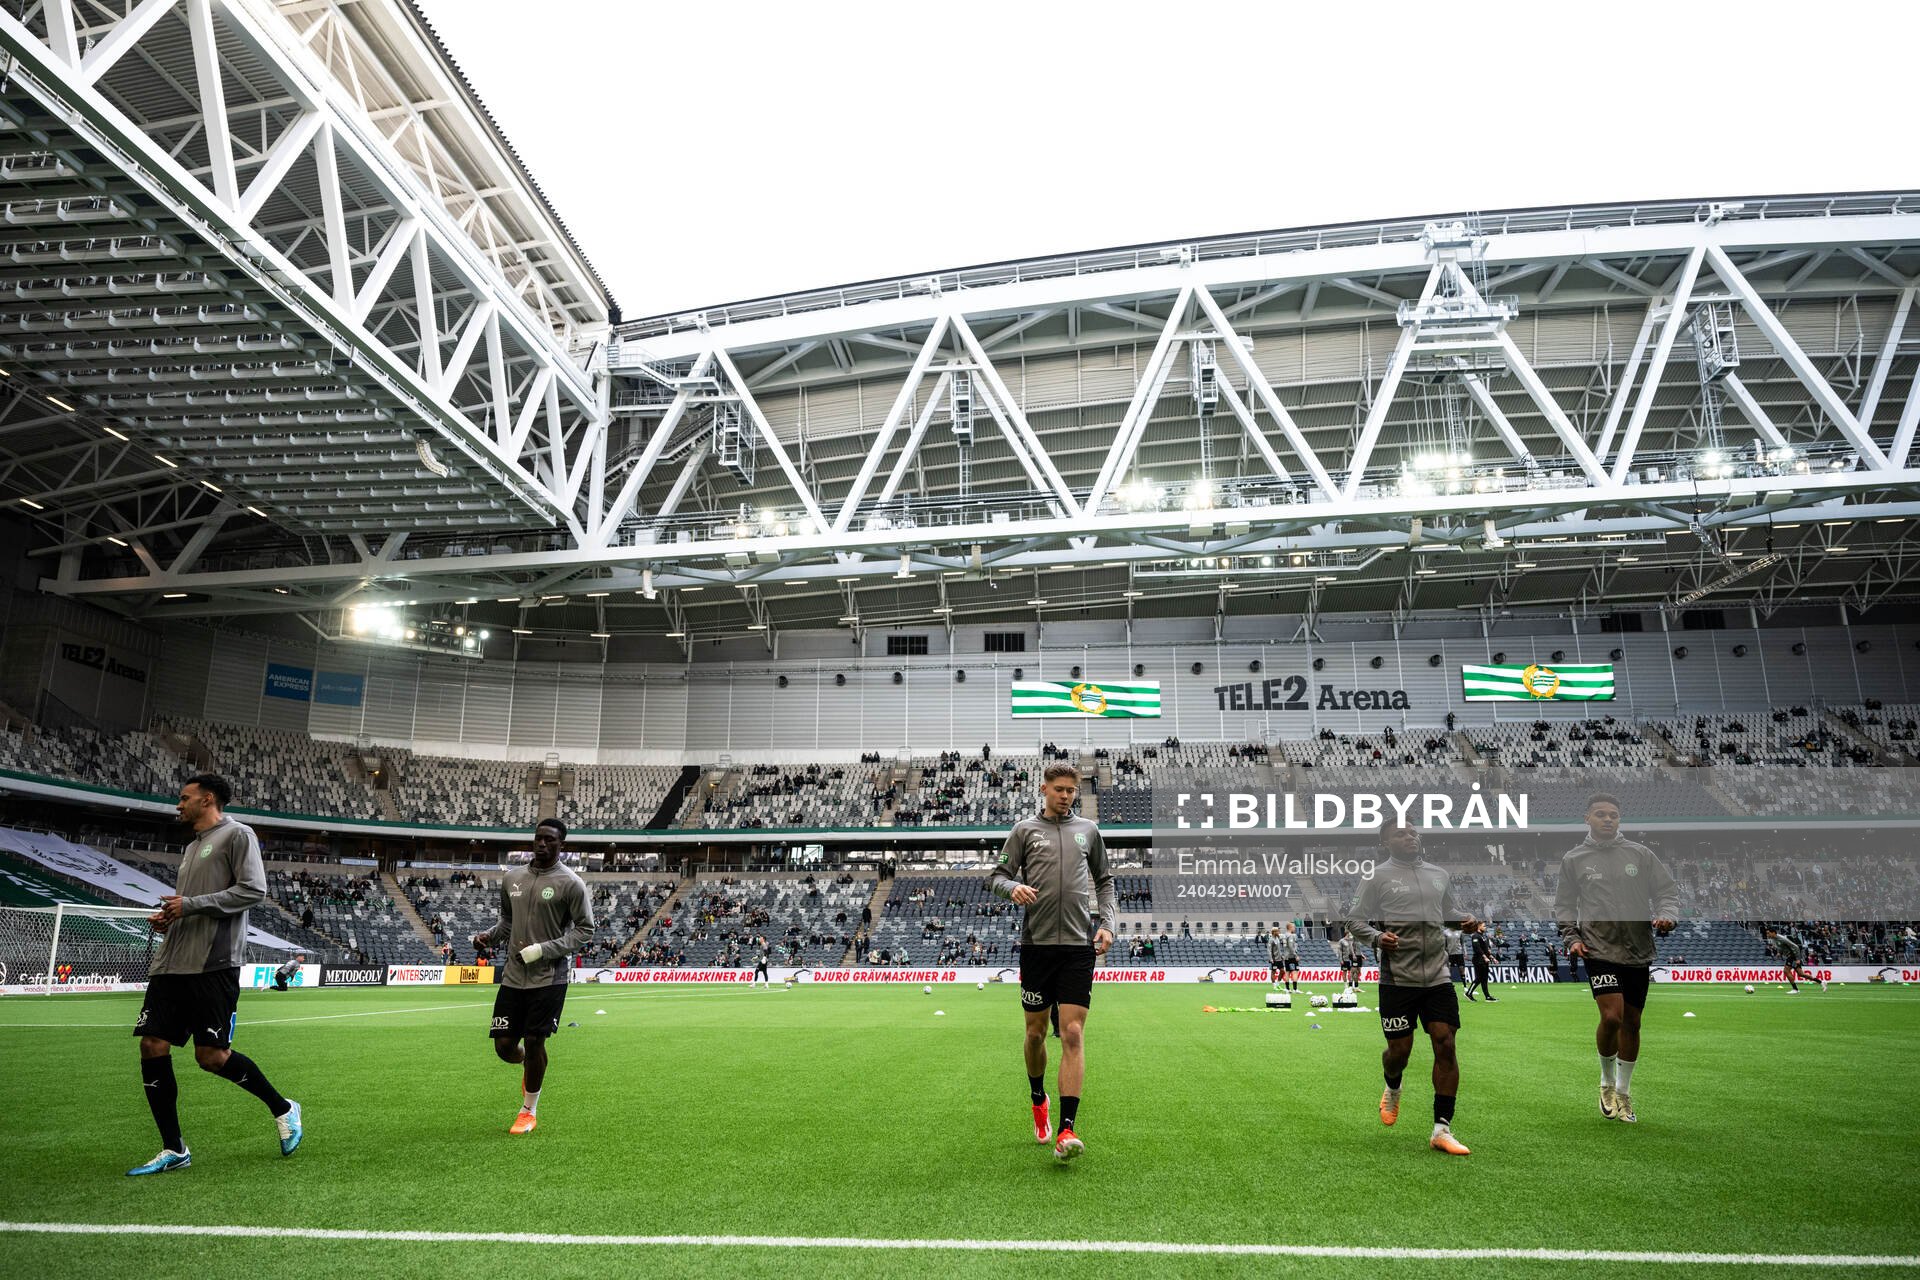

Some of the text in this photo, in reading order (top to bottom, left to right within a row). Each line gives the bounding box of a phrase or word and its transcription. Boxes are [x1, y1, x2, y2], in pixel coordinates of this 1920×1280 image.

[269, 674, 309, 686] AMERICAN
[273, 680, 309, 692] EXPRESS
[1214, 675, 1411, 710] TELE2 Arena
[325, 967, 383, 983] METODGOLV
[397, 969, 443, 982] INTERSPORT
[614, 969, 754, 982] DJURÖ GRÄVMASKINER AB
[814, 969, 956, 982] DJURÖ GRÄVMASKINER AB
[1092, 970, 1165, 982] MASKINER AB
[1229, 968, 1268, 982] DJURÖ
[1365, 970, 1380, 981] AB
[1464, 966, 1554, 983] ALSVENKAN
[1672, 967, 1712, 982] DJURÖ
[1816, 970, 1832, 981] AB
